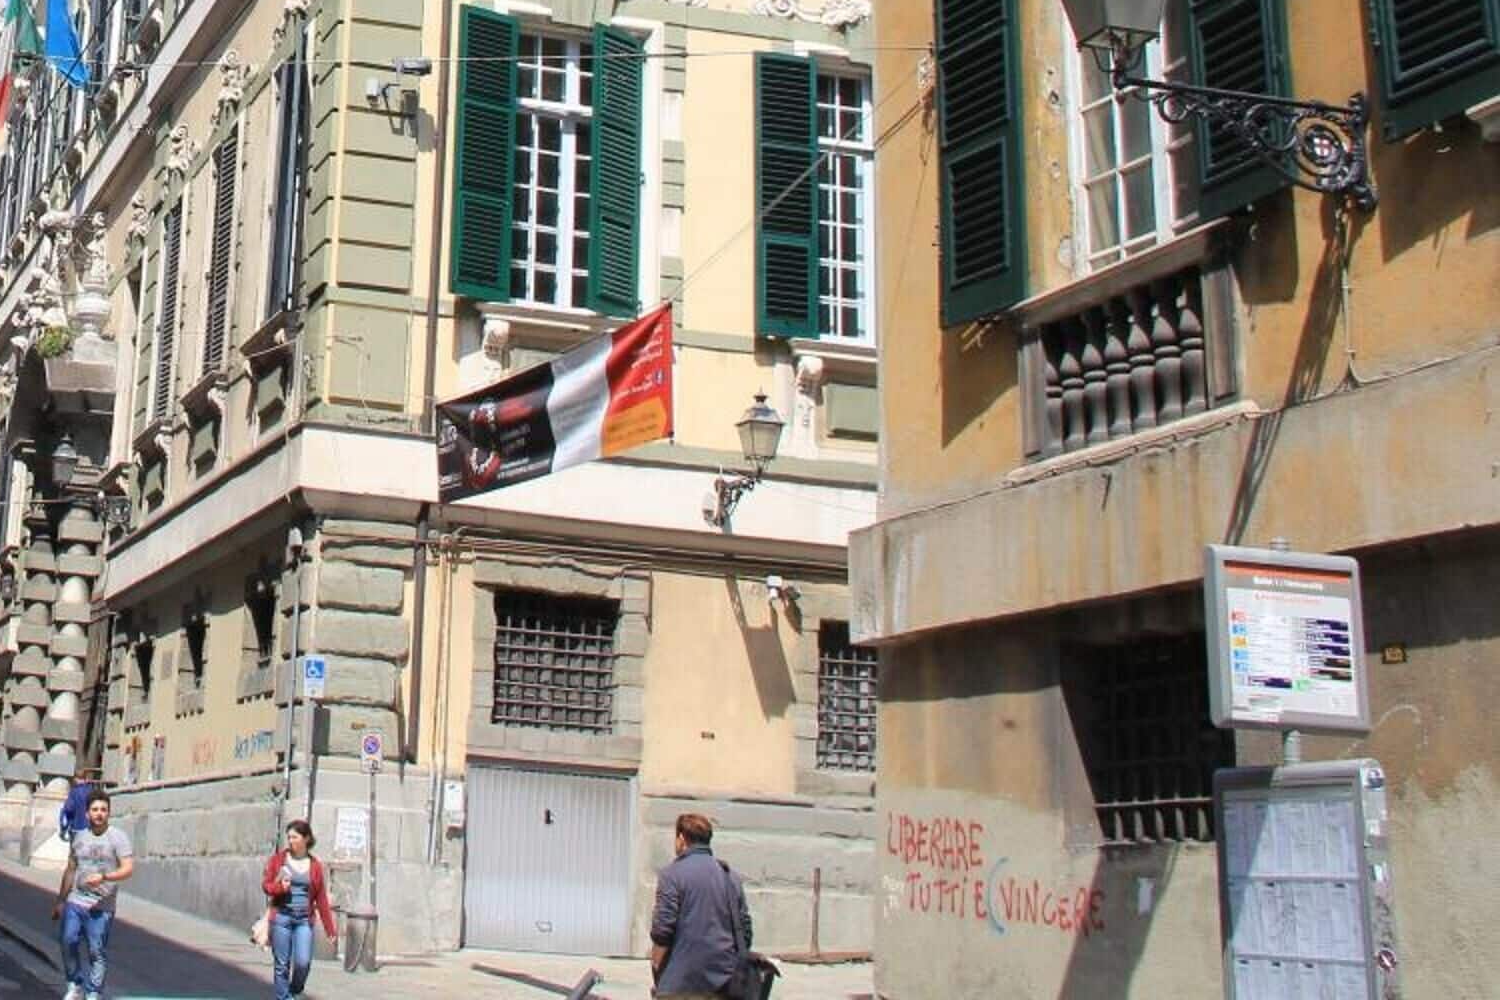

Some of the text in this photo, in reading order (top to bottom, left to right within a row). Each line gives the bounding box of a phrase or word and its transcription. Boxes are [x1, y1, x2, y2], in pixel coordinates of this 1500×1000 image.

[886, 811, 984, 872] LIBERARE
[973, 880, 987, 920] E
[1000, 876, 1107, 937] VINCERE
